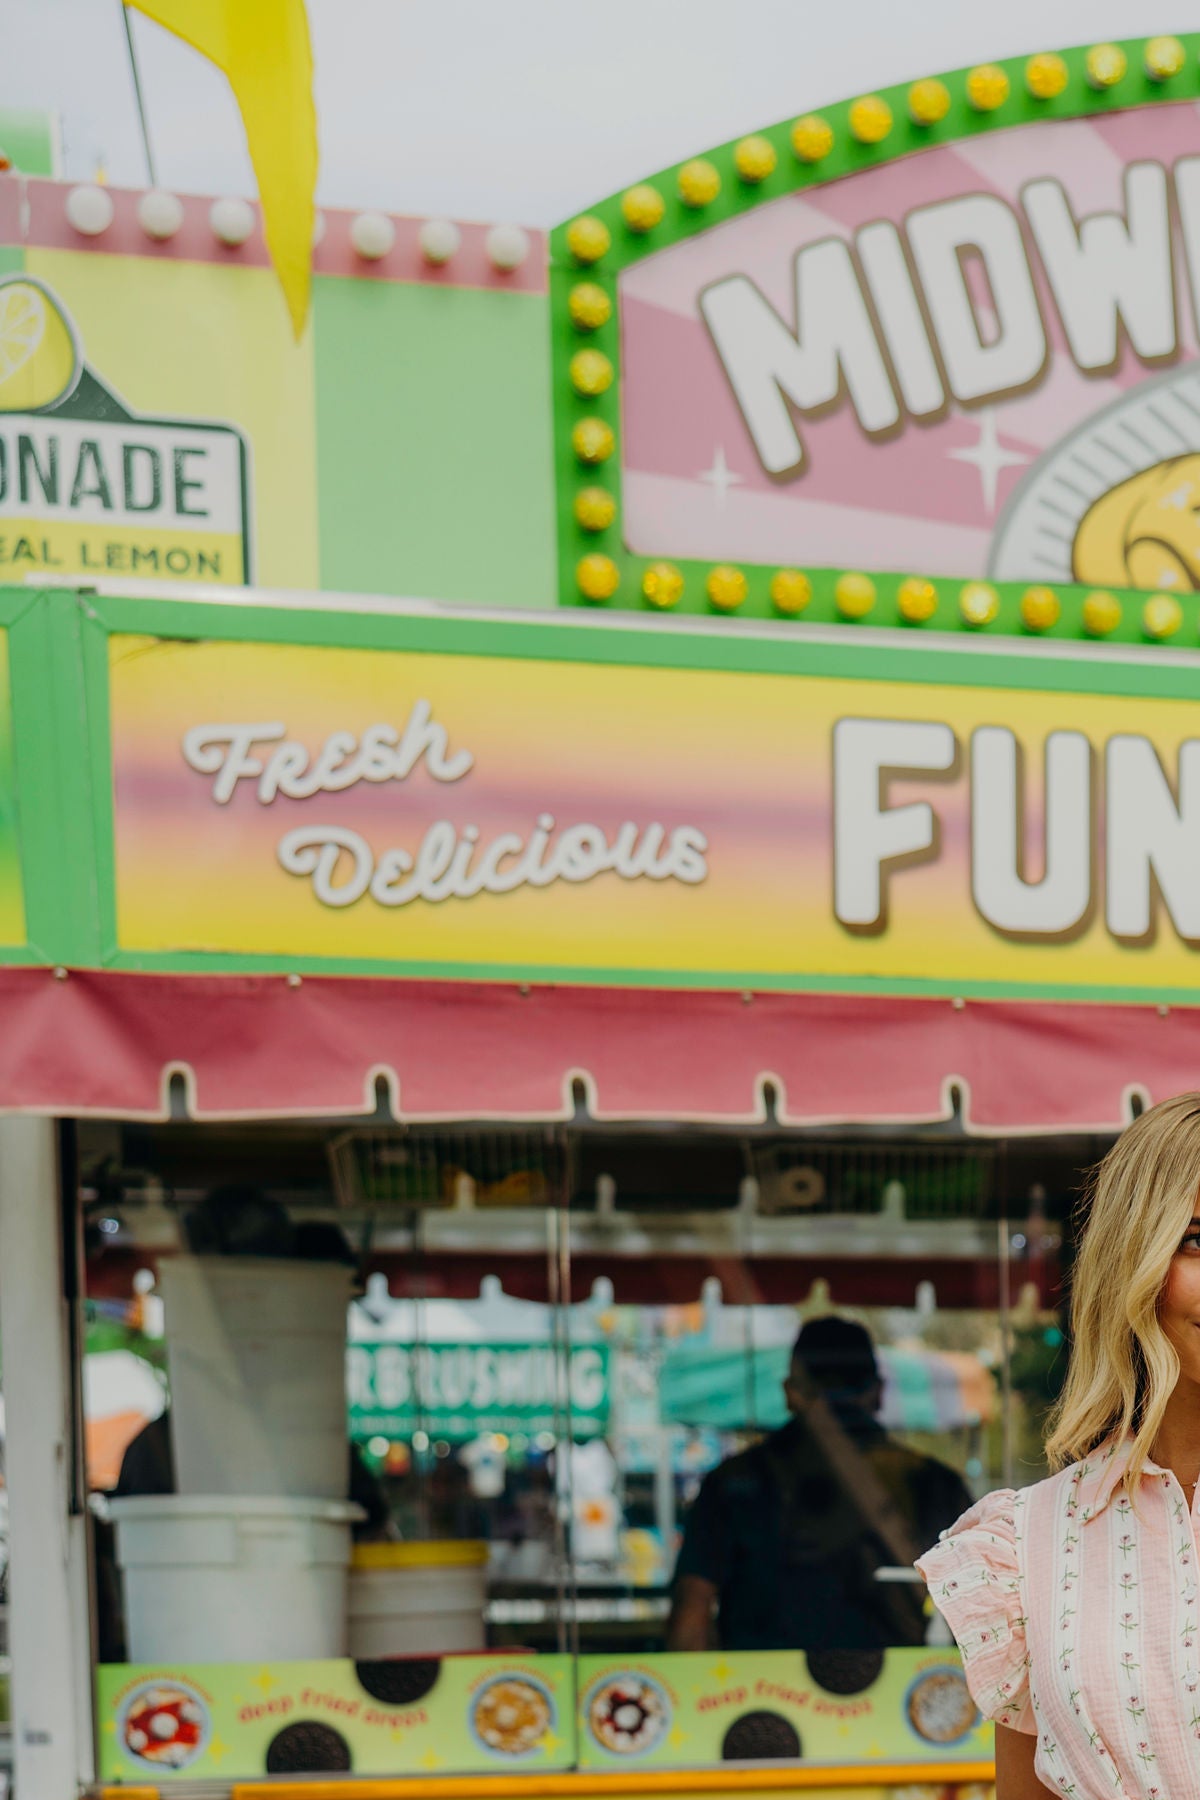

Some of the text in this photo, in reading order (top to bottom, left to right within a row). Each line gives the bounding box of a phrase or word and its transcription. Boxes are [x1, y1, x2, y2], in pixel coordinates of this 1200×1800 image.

[0, 434, 209, 517] NADE
[81, 542, 221, 577] LEMON
[182, 699, 474, 804] Fresh
[277, 812, 709, 908] Delicious
[239, 1695, 292, 1723] deep
[301, 1689, 360, 1717] fried
[755, 1679, 810, 1706] fried
